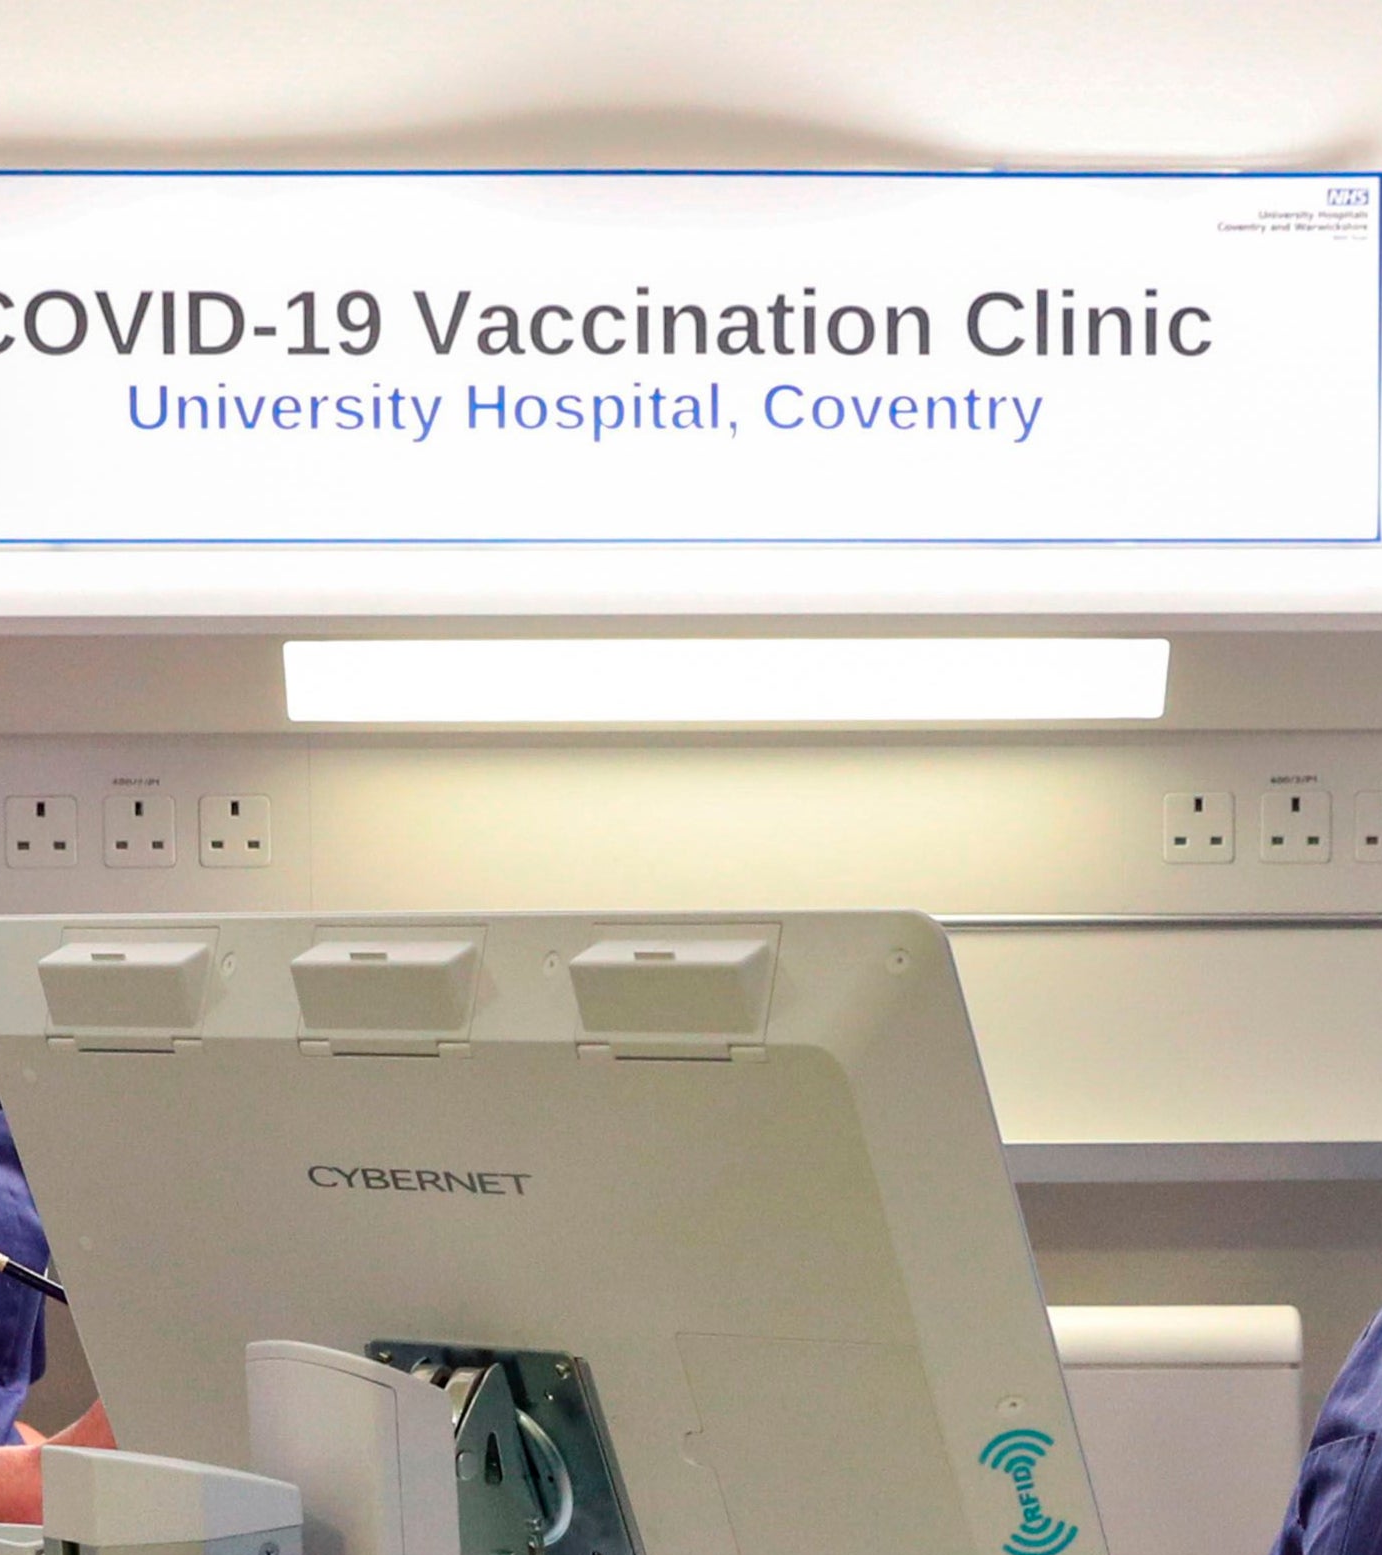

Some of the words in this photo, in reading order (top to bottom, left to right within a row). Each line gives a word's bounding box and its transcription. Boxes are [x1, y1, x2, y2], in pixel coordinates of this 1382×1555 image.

[1328, 188, 1369, 205] NHS
[1217, 221, 1267, 234] Coventry
[1270, 222, 1291, 232] and
[1294, 222, 1368, 232] Warwickshire
[1258, 211, 1315, 221] University
[1318, 211, 1369, 221] Hospitals
[412, 286, 931, 358] Vaccination
[966, 287, 1213, 358] Clinic
[128, 382, 443, 443] University
[467, 381, 738, 443] Hospital,
[763, 384, 1044, 444] Coventry
[307, 1165, 533, 1195] CYBERNET
[1013, 1466, 1042, 1523] RFID
